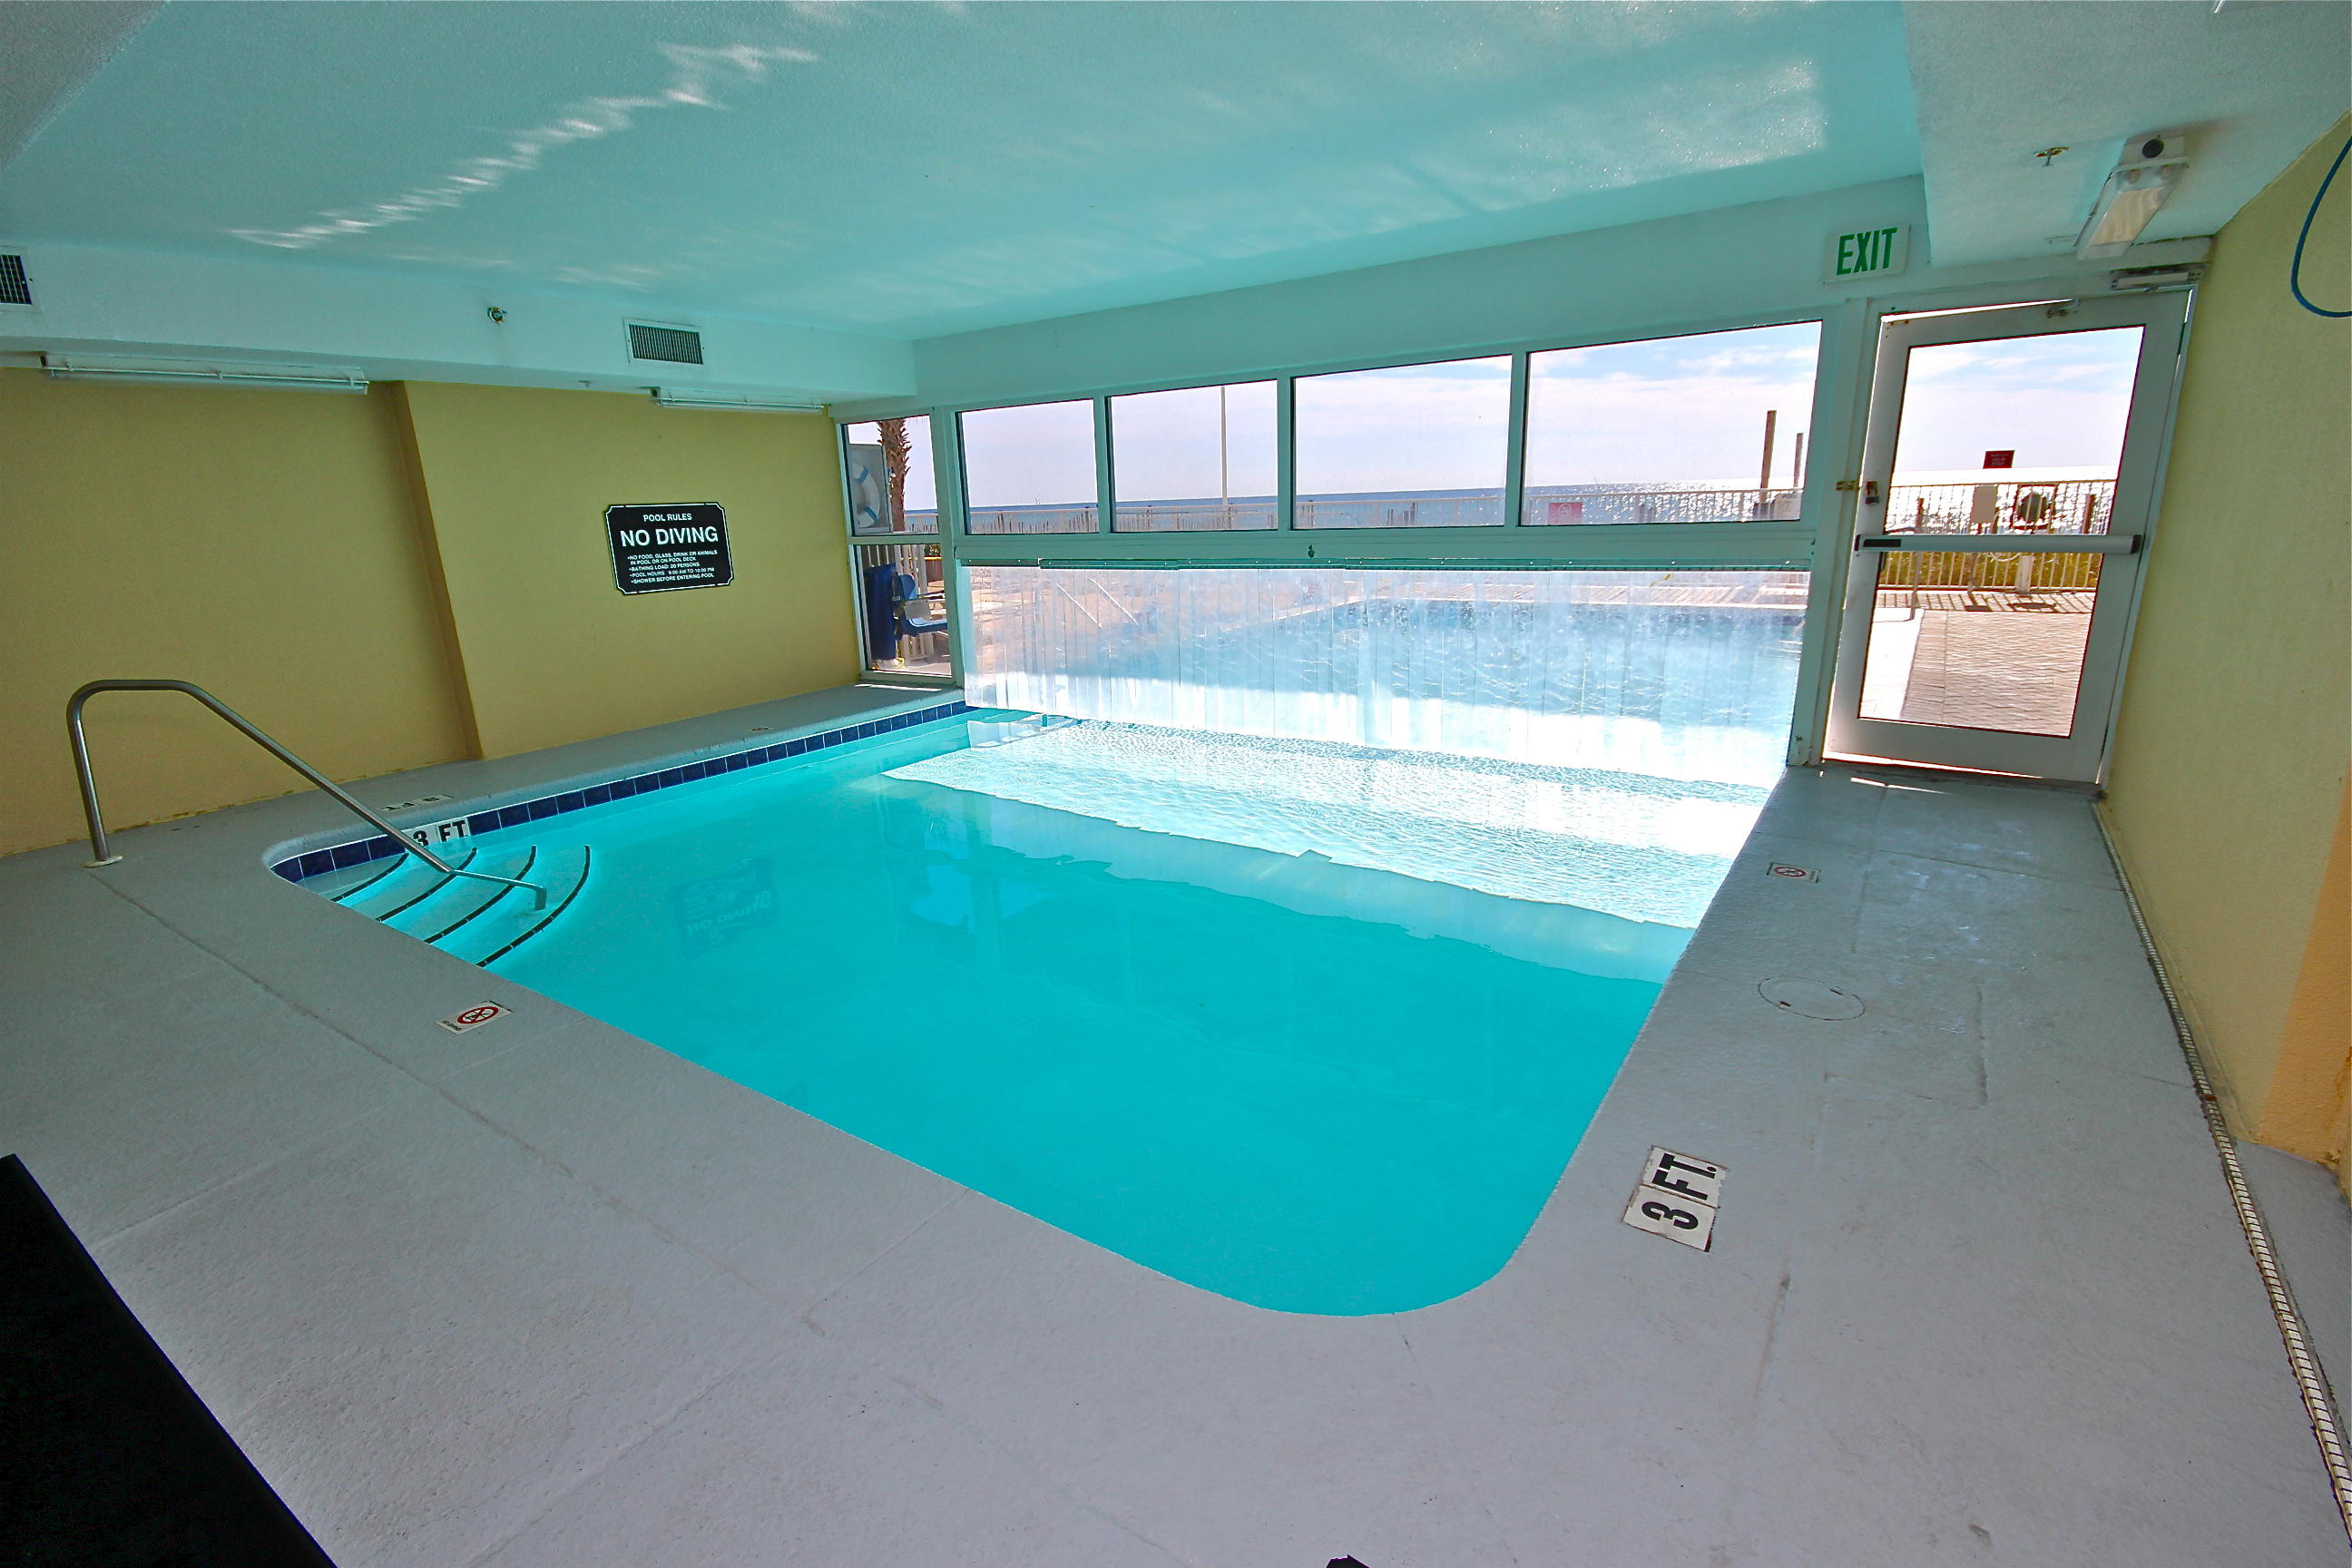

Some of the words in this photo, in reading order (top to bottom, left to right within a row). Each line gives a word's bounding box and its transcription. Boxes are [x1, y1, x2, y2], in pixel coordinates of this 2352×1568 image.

[1836, 227, 1898, 276] EXIT
[642, 514, 666, 522] POOL
[667, 513, 692, 521] RULES
[620, 529, 651, 547] NO
[655, 525, 719, 545] DIVING
[413, 830, 429, 848] 3
[438, 819, 466, 842] FT
[1651, 1152, 1718, 1201] FT.
[1641, 1200, 1699, 1230] 3
